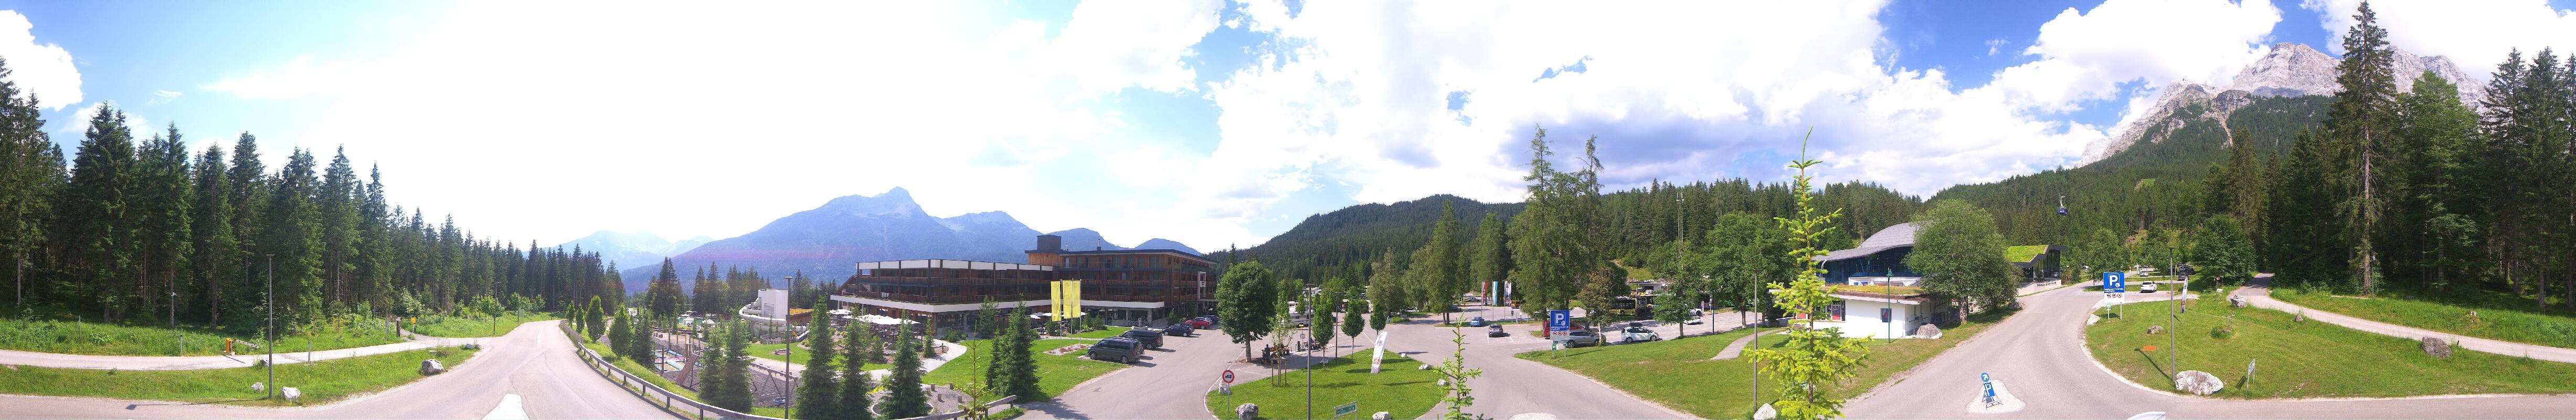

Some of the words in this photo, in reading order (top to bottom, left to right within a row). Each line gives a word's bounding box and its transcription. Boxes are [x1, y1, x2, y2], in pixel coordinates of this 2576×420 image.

[2109, 275, 2118, 286] P
[1556, 313, 1564, 324] P
[1985, 383, 1991, 396] P
